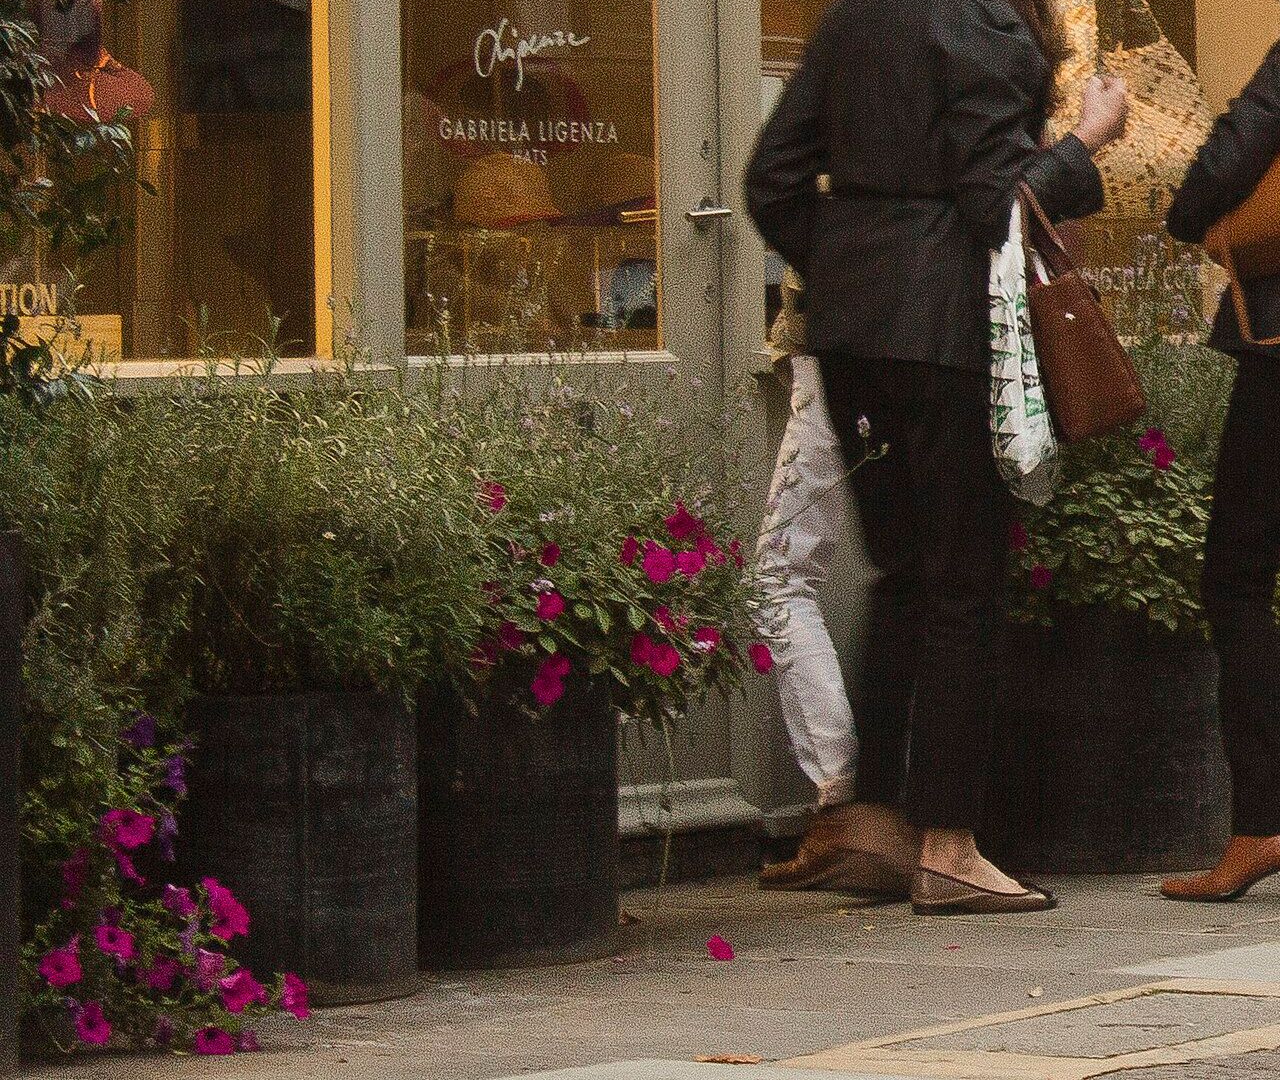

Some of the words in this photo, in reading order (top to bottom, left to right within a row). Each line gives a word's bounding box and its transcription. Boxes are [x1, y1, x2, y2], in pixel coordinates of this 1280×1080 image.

[438, 118, 531, 142] GABRIELA
[539, 121, 619, 144] LIGENZA
[513, 149, 549, 166] HATS
